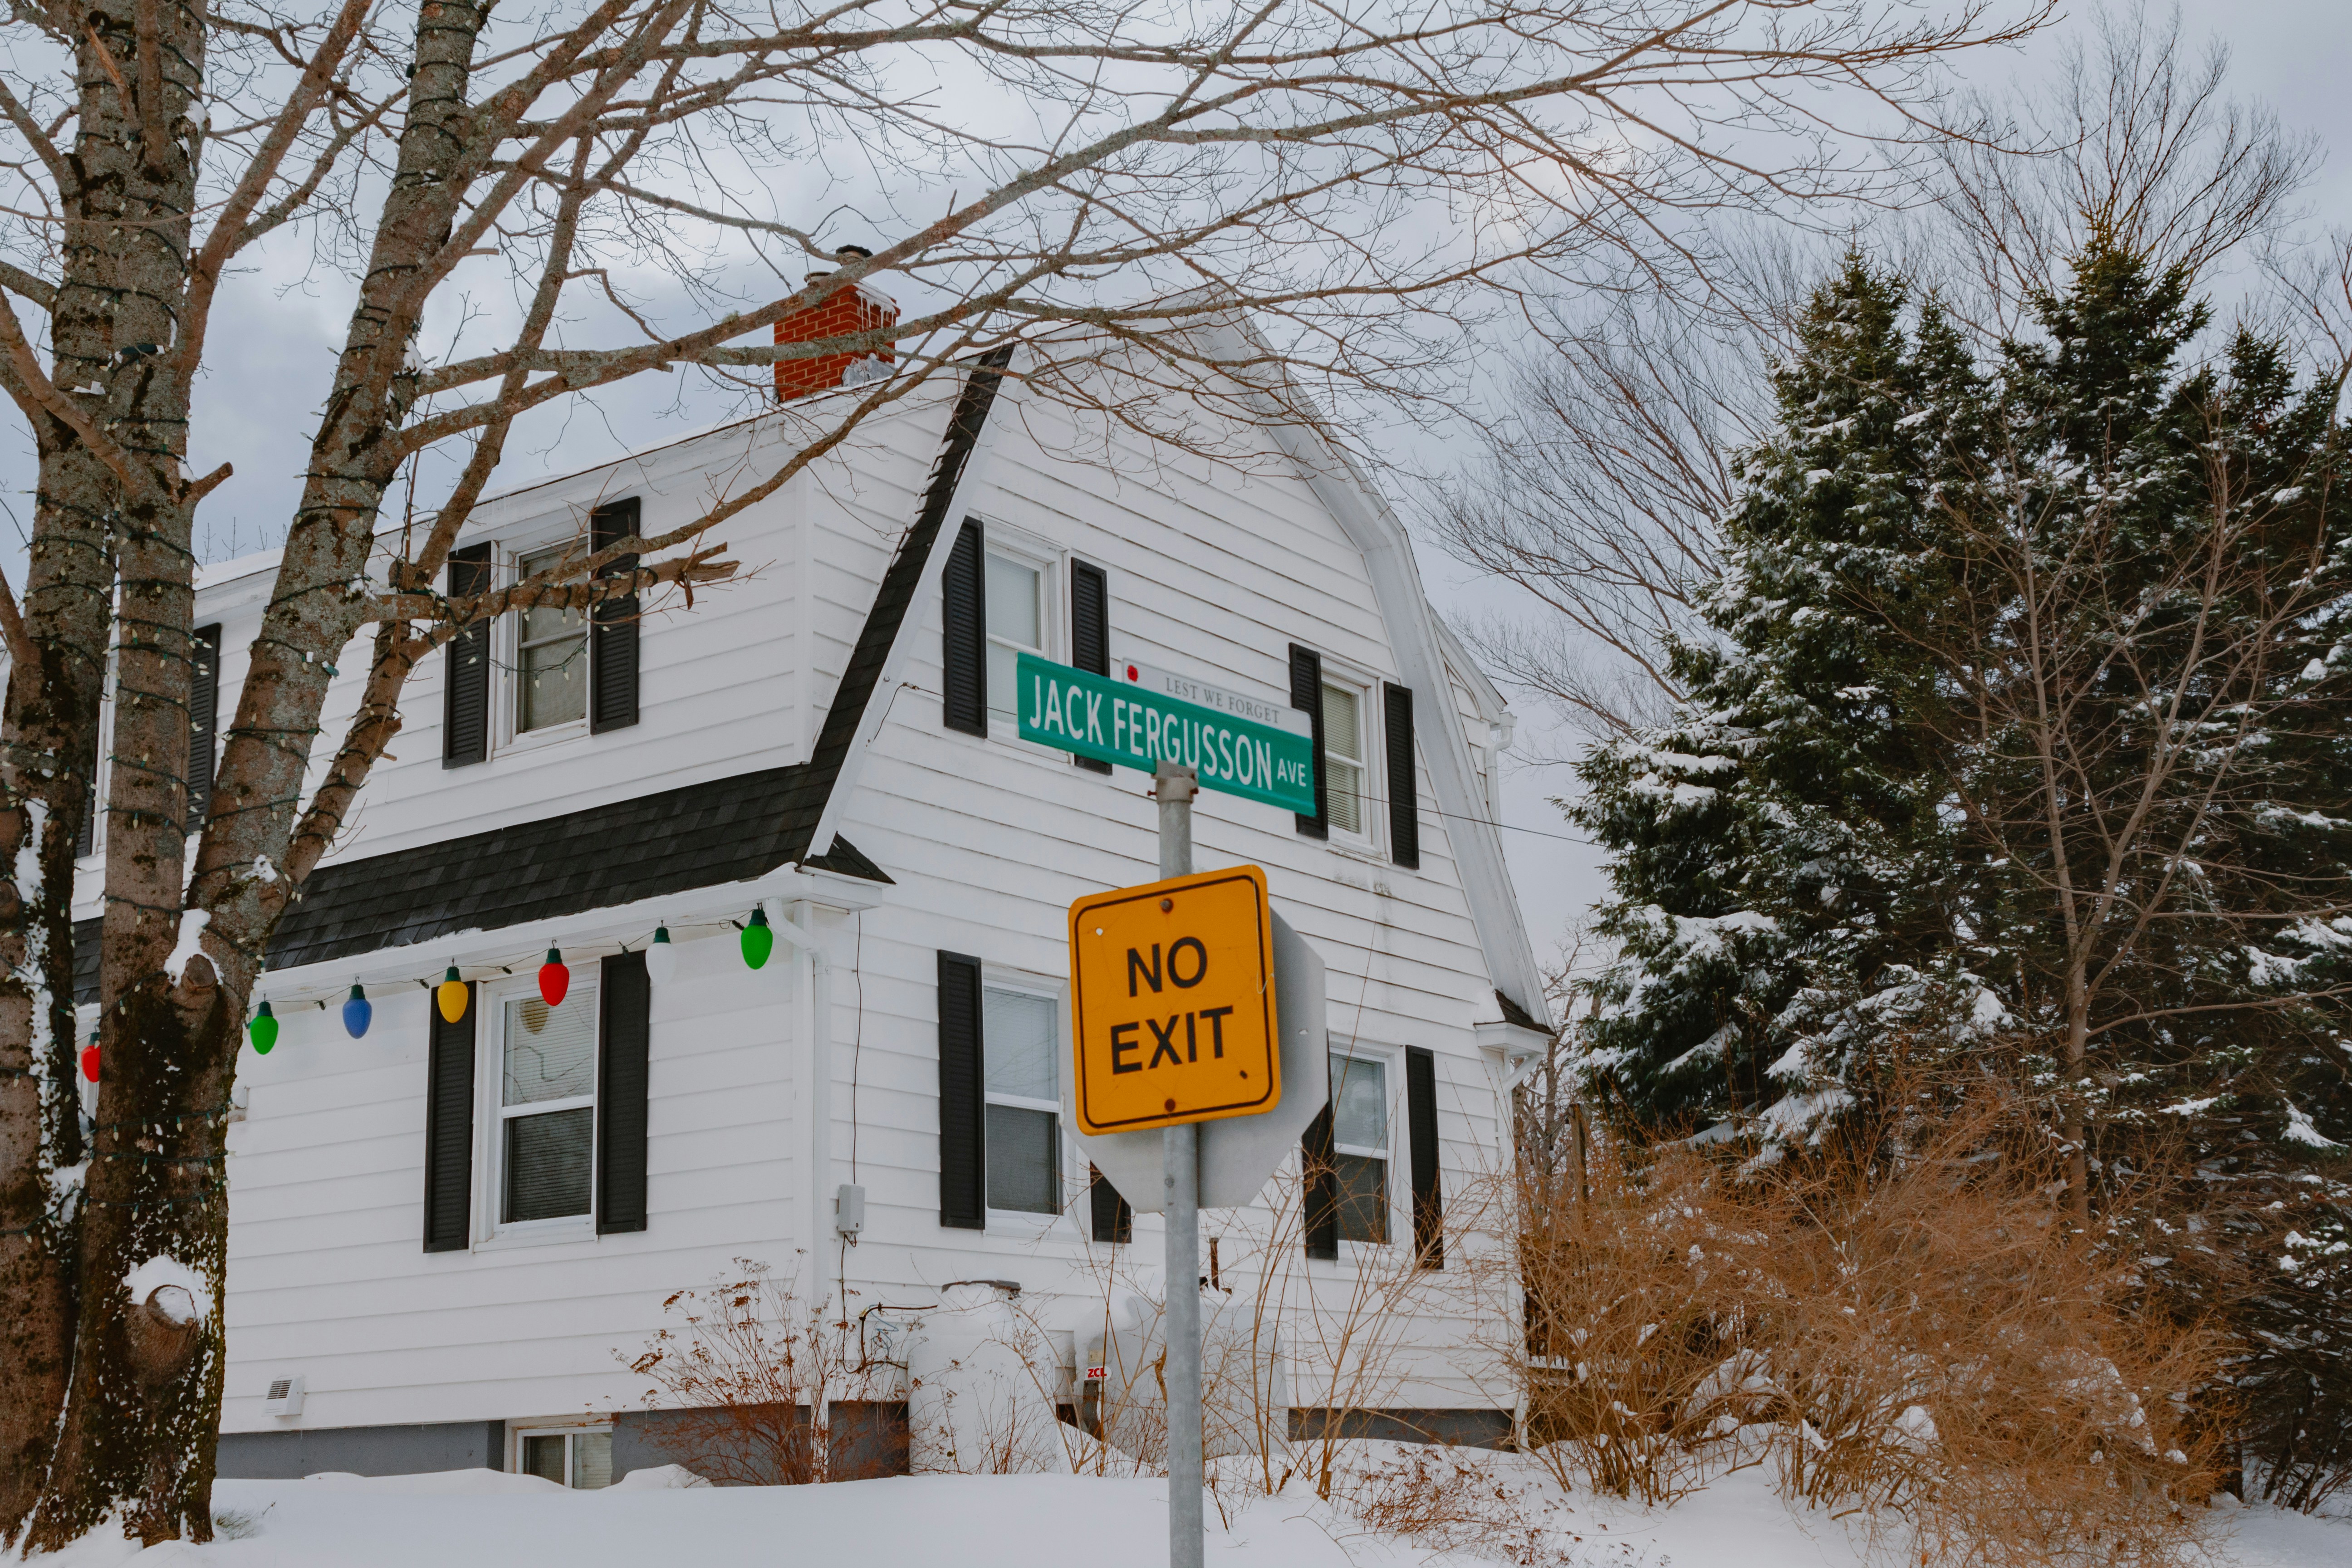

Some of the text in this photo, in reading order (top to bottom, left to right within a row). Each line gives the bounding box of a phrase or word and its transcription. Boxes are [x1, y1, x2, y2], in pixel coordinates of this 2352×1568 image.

[1166, 678, 1279, 723] LEST WE FORGET
[1029, 675, 1307, 791] JACK FERGUSSON AVE
[1127, 936, 1208, 997] NO
[1110, 1005, 1233, 1075] EXIT
[1088, 1367, 1107, 1378] ZCL
